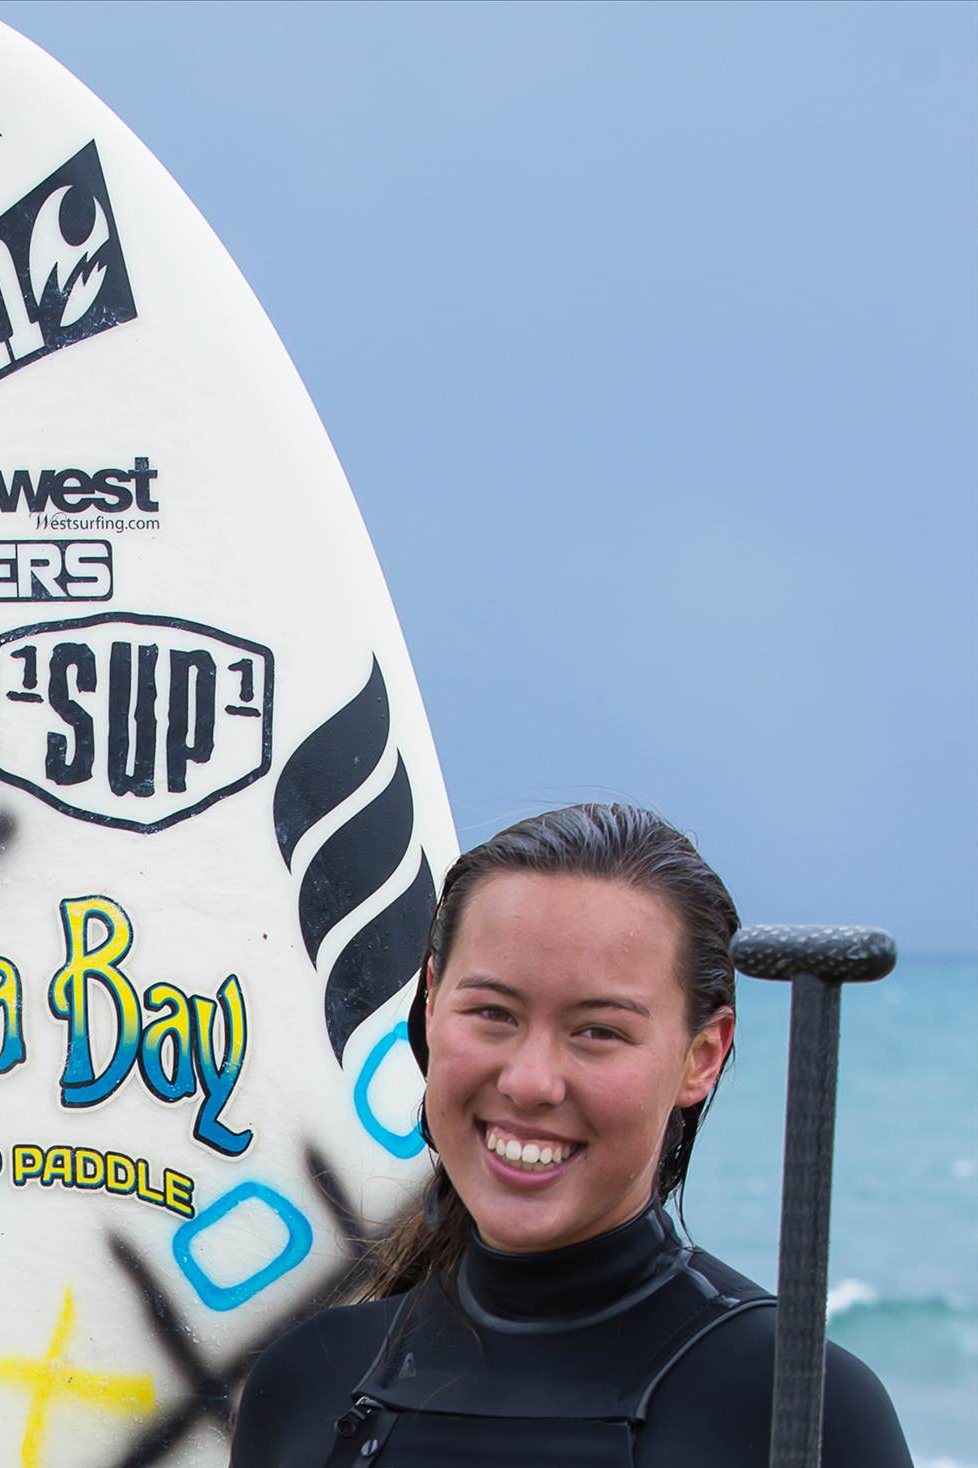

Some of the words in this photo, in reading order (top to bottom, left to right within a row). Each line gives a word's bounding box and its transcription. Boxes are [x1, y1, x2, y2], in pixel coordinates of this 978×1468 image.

[30, 512, 160, 533] Westsurfing.com
[48, 894, 254, 1158] Bay
[12, 1144, 196, 1220] PADDLE
